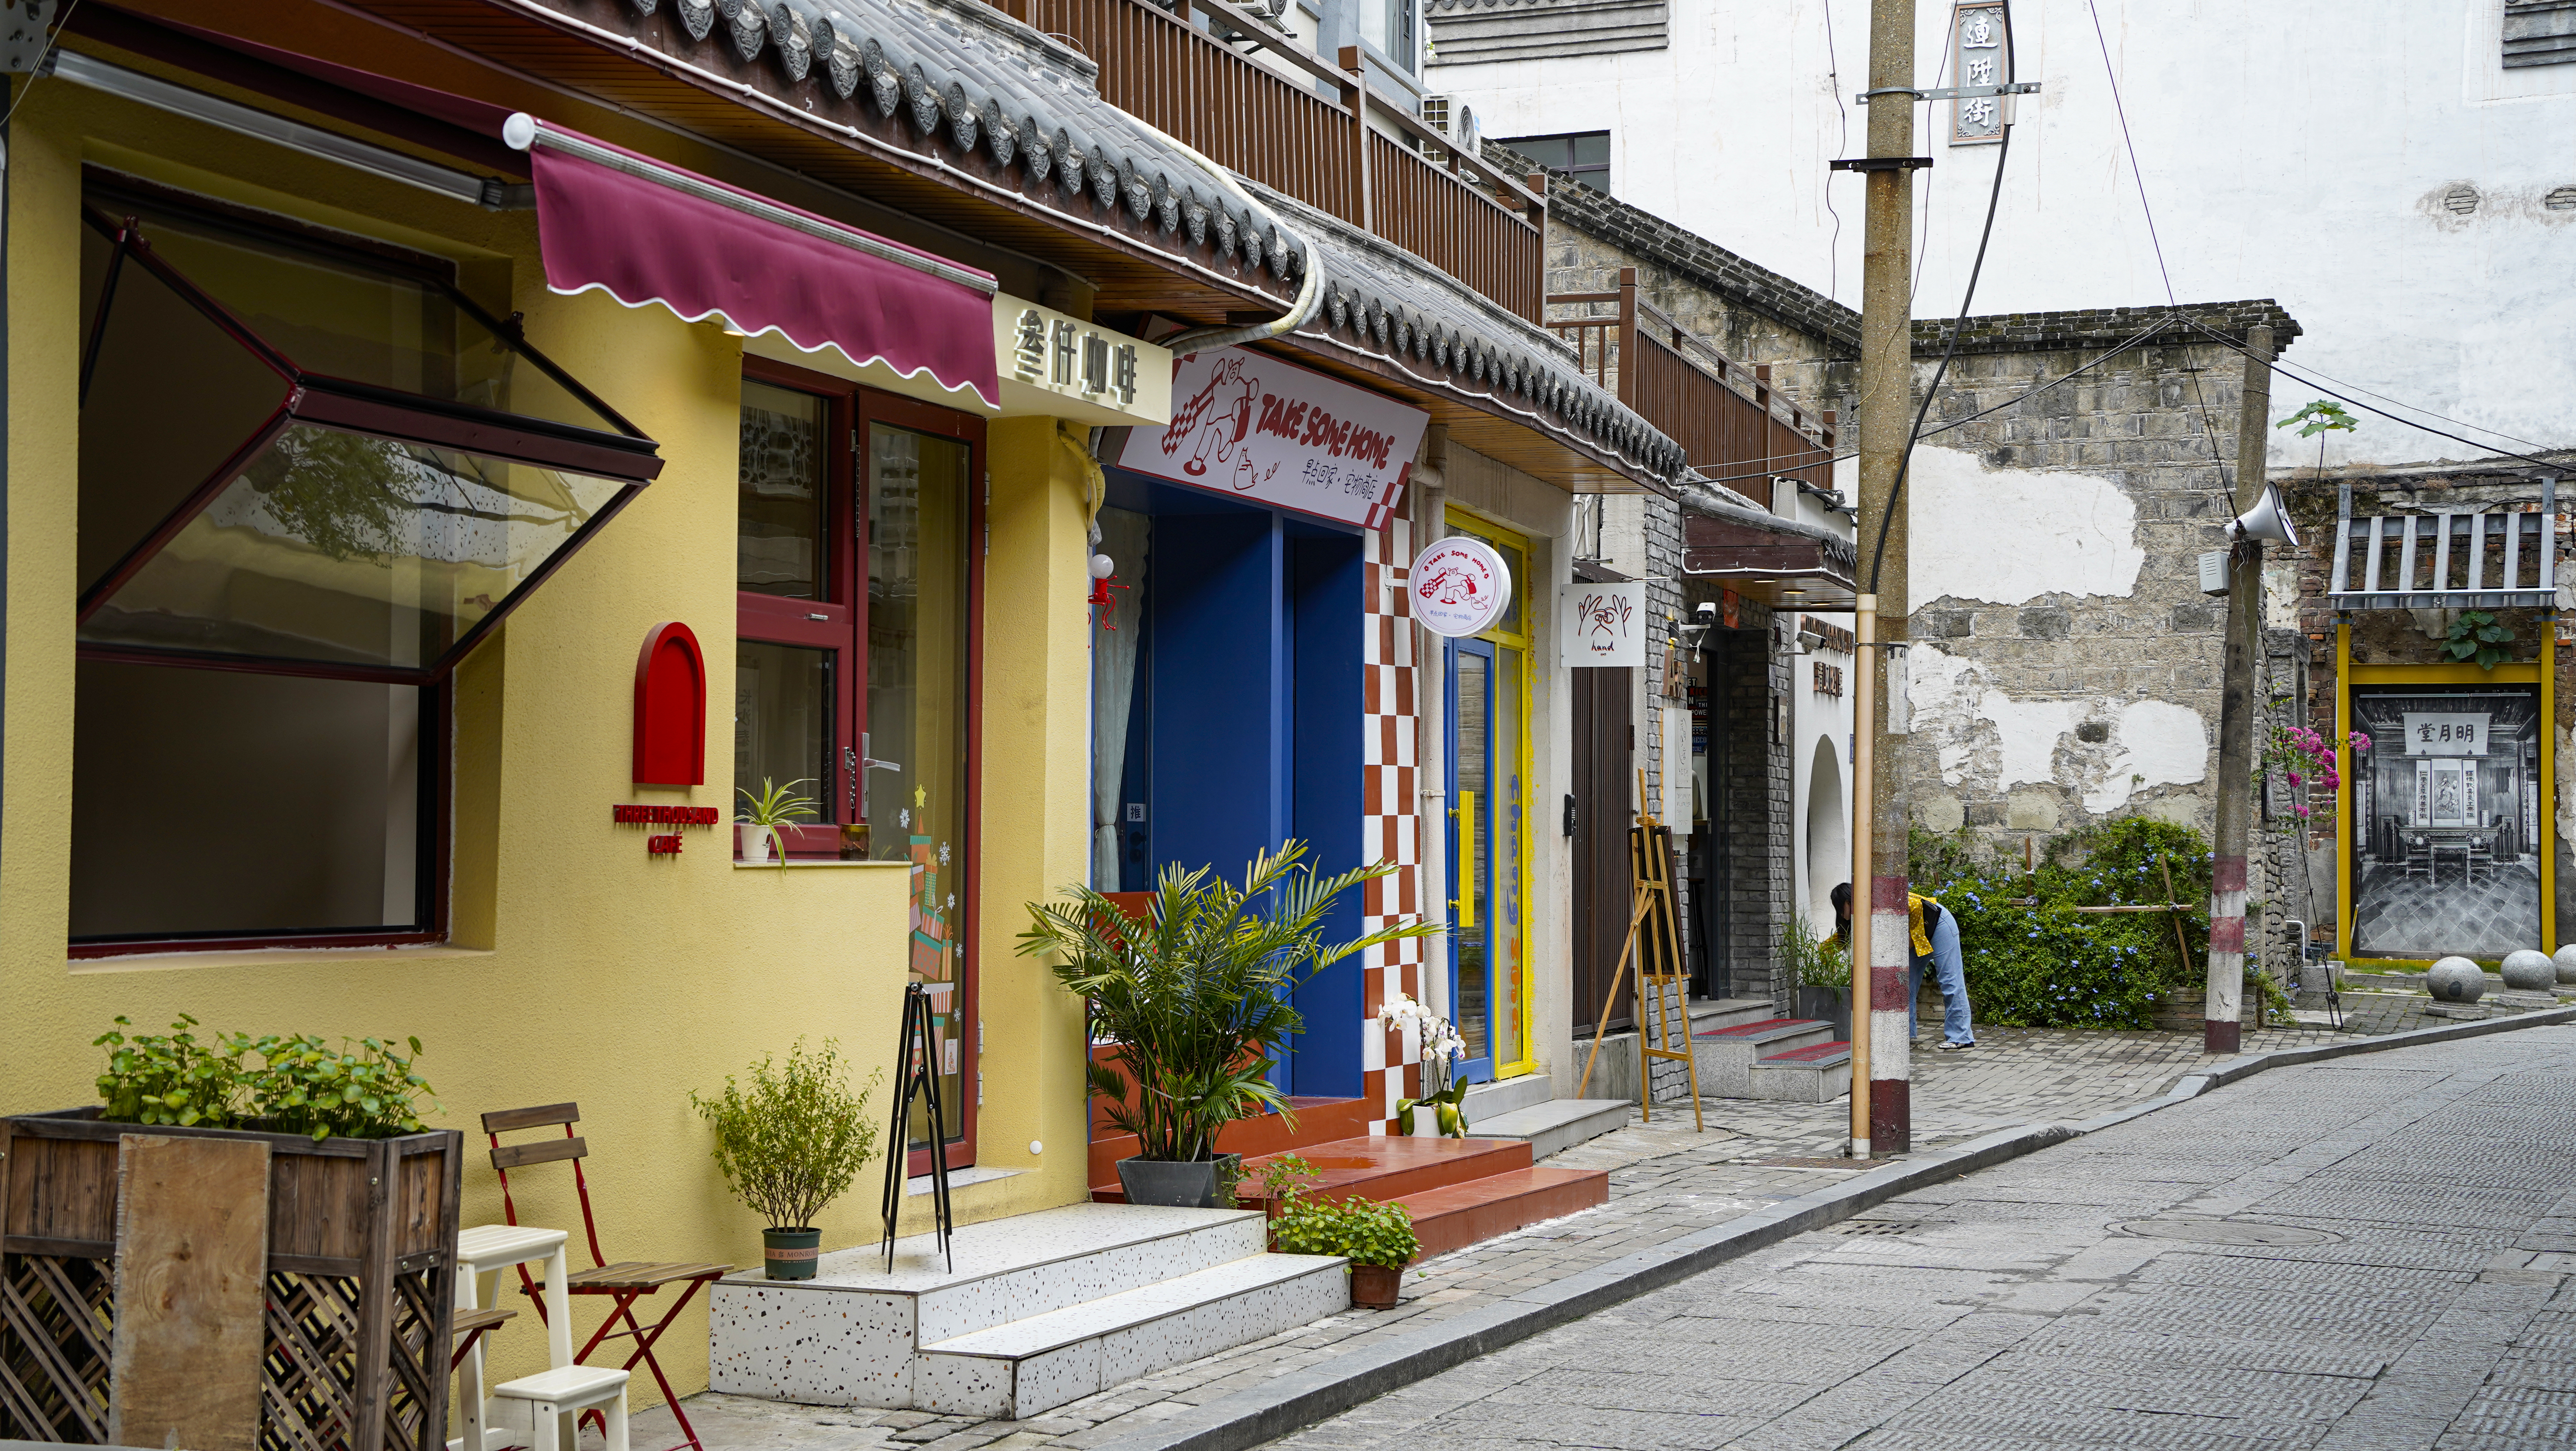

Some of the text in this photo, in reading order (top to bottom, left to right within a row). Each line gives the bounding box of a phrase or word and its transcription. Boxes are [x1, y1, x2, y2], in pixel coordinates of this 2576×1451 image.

[1014, 309, 1137, 404] 叁仟咖啡
[1256, 393, 1395, 470] TAKE SOME HOME
[1428, 552, 1446, 566] TAKE
[1451, 550, 1468, 559] SOME
[1472, 558, 1487, 573] HOME
[1591, 640, 1615, 652] hand
[613, 804, 719, 824] THREE THOUSAND
[1130, 806, 1141, 819] 推
[648, 831, 683, 853] CAFÉ
